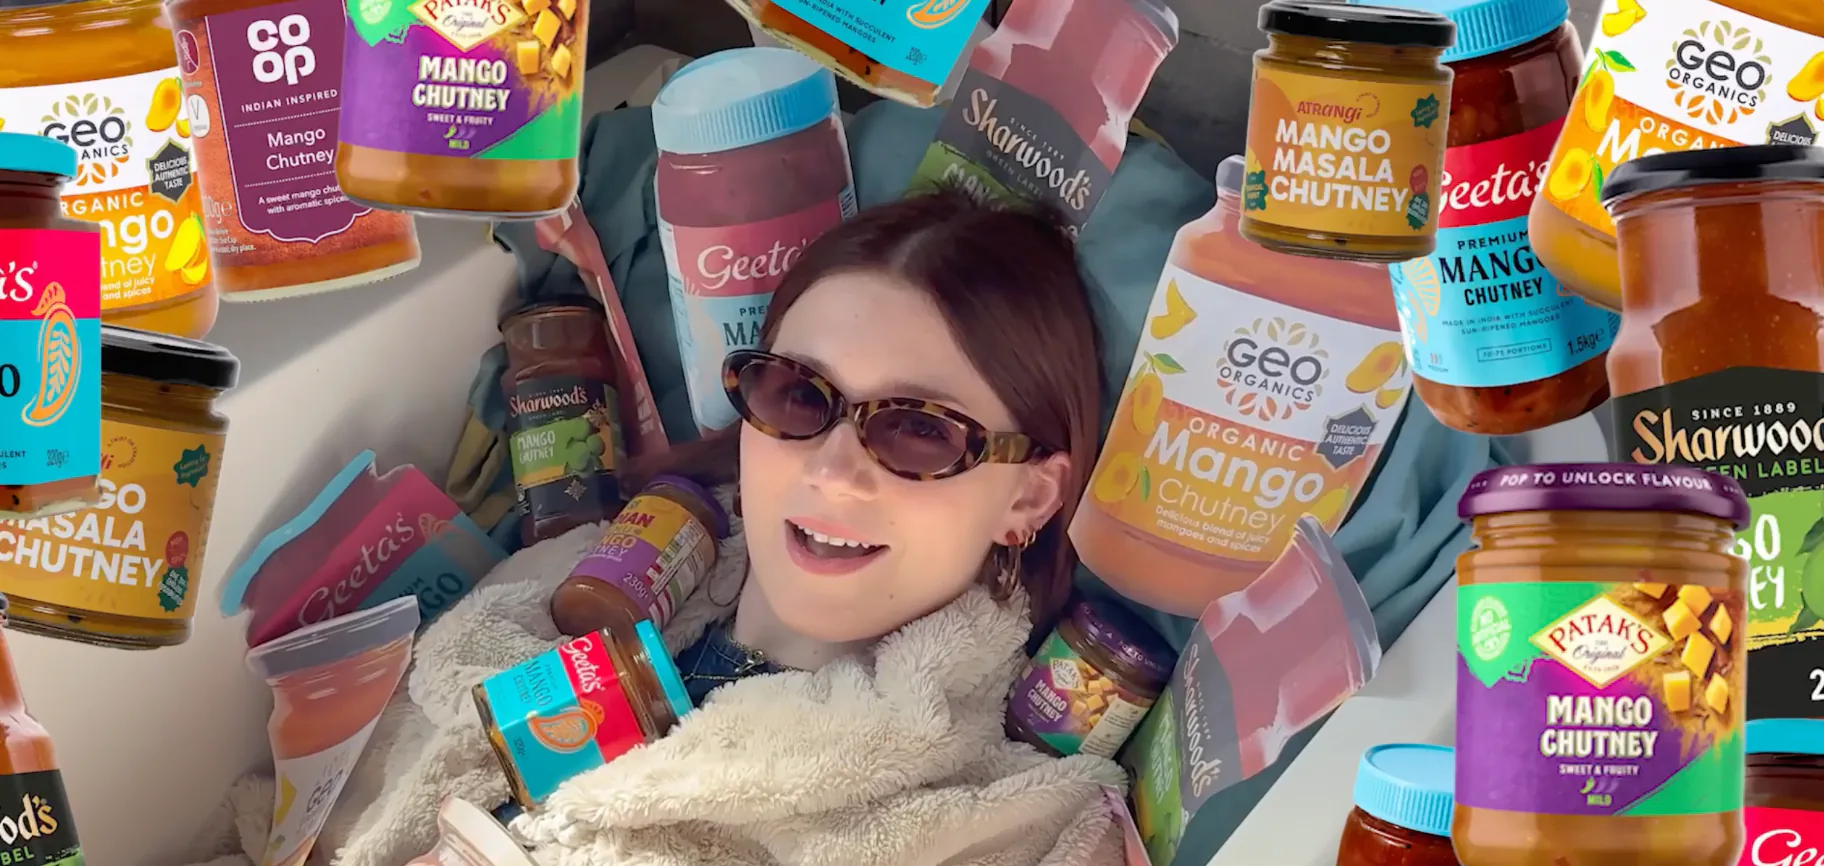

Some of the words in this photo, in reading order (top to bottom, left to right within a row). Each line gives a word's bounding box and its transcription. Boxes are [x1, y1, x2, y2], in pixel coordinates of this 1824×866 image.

[835, 5, 855, 22] WITH
[855, 16, 896, 43] SUCCULENT
[842, 19, 877, 44] MANGOES
[418, 54, 508, 86] MANGO
[1676, 39, 1766, 91] Geo
[241, 99, 282, 113] INDIAN
[286, 88, 339, 106] INSPIRED
[412, 83, 511, 112] CHUTNEY
[1669, 68, 1759, 107] ORGANICS
[427, 112, 455, 124] SWEET
[464, 115, 494, 126] FRUITY
[267, 128, 326, 148] Mango
[448, 138, 470, 150] MILD
[962, 87, 1092, 212] Sharwood's
[1274, 117, 1391, 155] MANGO
[1773, 130, 1814, 146] DELICIOUS
[153, 156, 188, 172] DELICIOUS
[266, 149, 335, 170] Chutney
[1272, 146, 1394, 184] MASALA
[154, 167, 189, 182] AUTHENTIC
[164, 178, 184, 190] TASTE
[258, 196, 266, 205] A
[266, 193, 290, 204] sweet
[291, 188, 322, 200] mango
[267, 203, 285, 214] with
[286, 198, 323, 211] aromatic
[1270, 175, 1409, 213] CHUTNEY
[1439, 247, 1547, 285] MANG
[122, 286, 152, 299] spices
[133, 275, 155, 288] juicy
[1463, 276, 1543, 306] CHUTNEY
[1441, 319, 1464, 327] MADE
[1466, 318, 1476, 326] IN
[1477, 315, 1501, 325] INDIA
[1504, 312, 1526, 321] WITH
[1528, 300, 1574, 317] SUCCULENT
[1519, 314, 1561, 327] MANGOES
[1227, 337, 1323, 386] Geo
[1506, 342, 1547, 357] PORTIONS
[1219, 365, 1315, 403] ORGANICS
[509, 384, 589, 418] Sharwood's
[1691, 405, 1744, 421] SINCE
[1753, 401, 1797, 416] 1889
[517, 430, 556, 451] MANGO
[1188, 416, 1306, 463] ORGANIC
[1325, 434, 1368, 446] AUTHENTIC
[1330, 423, 1372, 435] DELICIOUS
[1144, 420, 1325, 509] Mango
[1332, 445, 1356, 456] TASTE
[1499, 472, 1528, 487] POP
[1533, 471, 1553, 485] TO
[1562, 471, 1636, 485] UNLOCK
[1642, 472, 1713, 491] FLAVOUR
[1757, 458, 1824, 479] LABEL
[1158, 477, 1287, 536] Chutney
[1155, 504, 1201, 528] Delicious
[1202, 521, 1235, 537] blend
[1235, 530, 1246, 540] of
[1156, 518, 1205, 541] mangoes
[1206, 535, 1229, 548] and
[1229, 540, 1262, 553] spices
[297, 517, 416, 629] Geeta's
[1548, 613, 1655, 656] PATAK'S
[560, 635, 602, 694] Geeta's
[1572, 644, 1628, 665] Original
[524, 659, 553, 708] MANGO
[1035, 679, 1068, 712] MANGO
[1026, 688, 1064, 723] CHUTNEY
[1546, 695, 1653, 727] MANGO
[1539, 729, 1659, 758] CHUTNEY
[1559, 763, 1593, 775] SWEET
[1594, 764, 1602, 775] &
[1602, 764, 1640, 776] FRUITY
[1587, 794, 1613, 806] MILD
